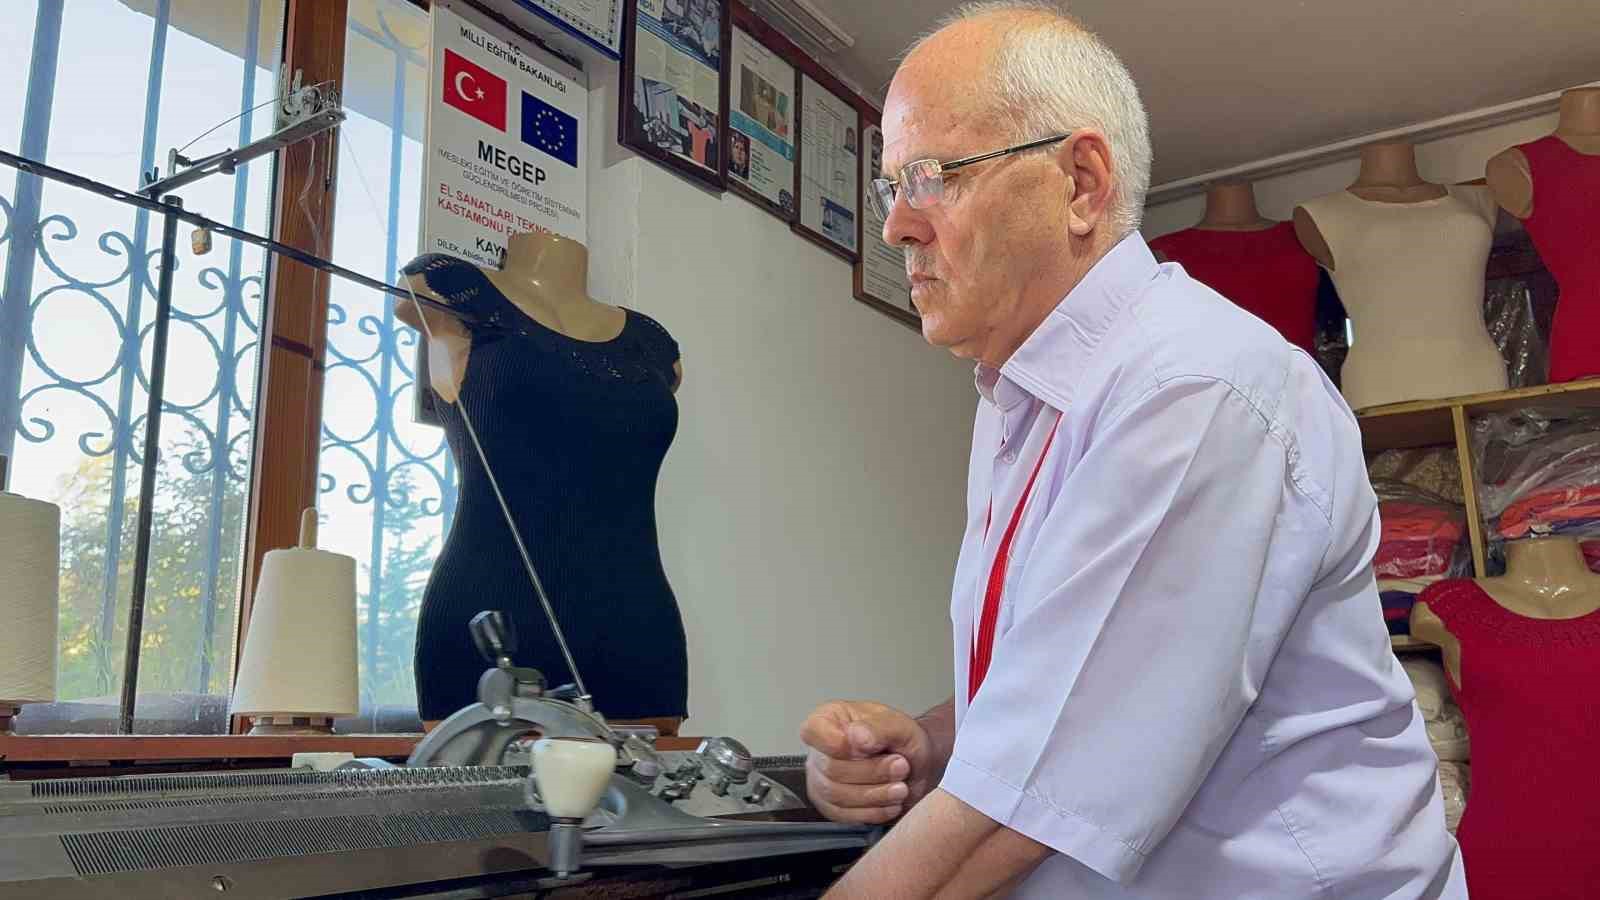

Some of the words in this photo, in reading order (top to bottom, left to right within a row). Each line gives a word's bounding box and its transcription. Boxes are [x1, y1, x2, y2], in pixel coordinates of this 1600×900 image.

[460, 26, 485, 48] MİLLİ
[486, 42, 518, 66] EĞİTİM
[519, 60, 567, 94] BAKANLIĞI
[478, 140, 546, 186] MEGEP
[438, 197, 504, 232] KASTAMONU
[440, 183, 453, 197] EL
[456, 190, 514, 223] SANATLARI
